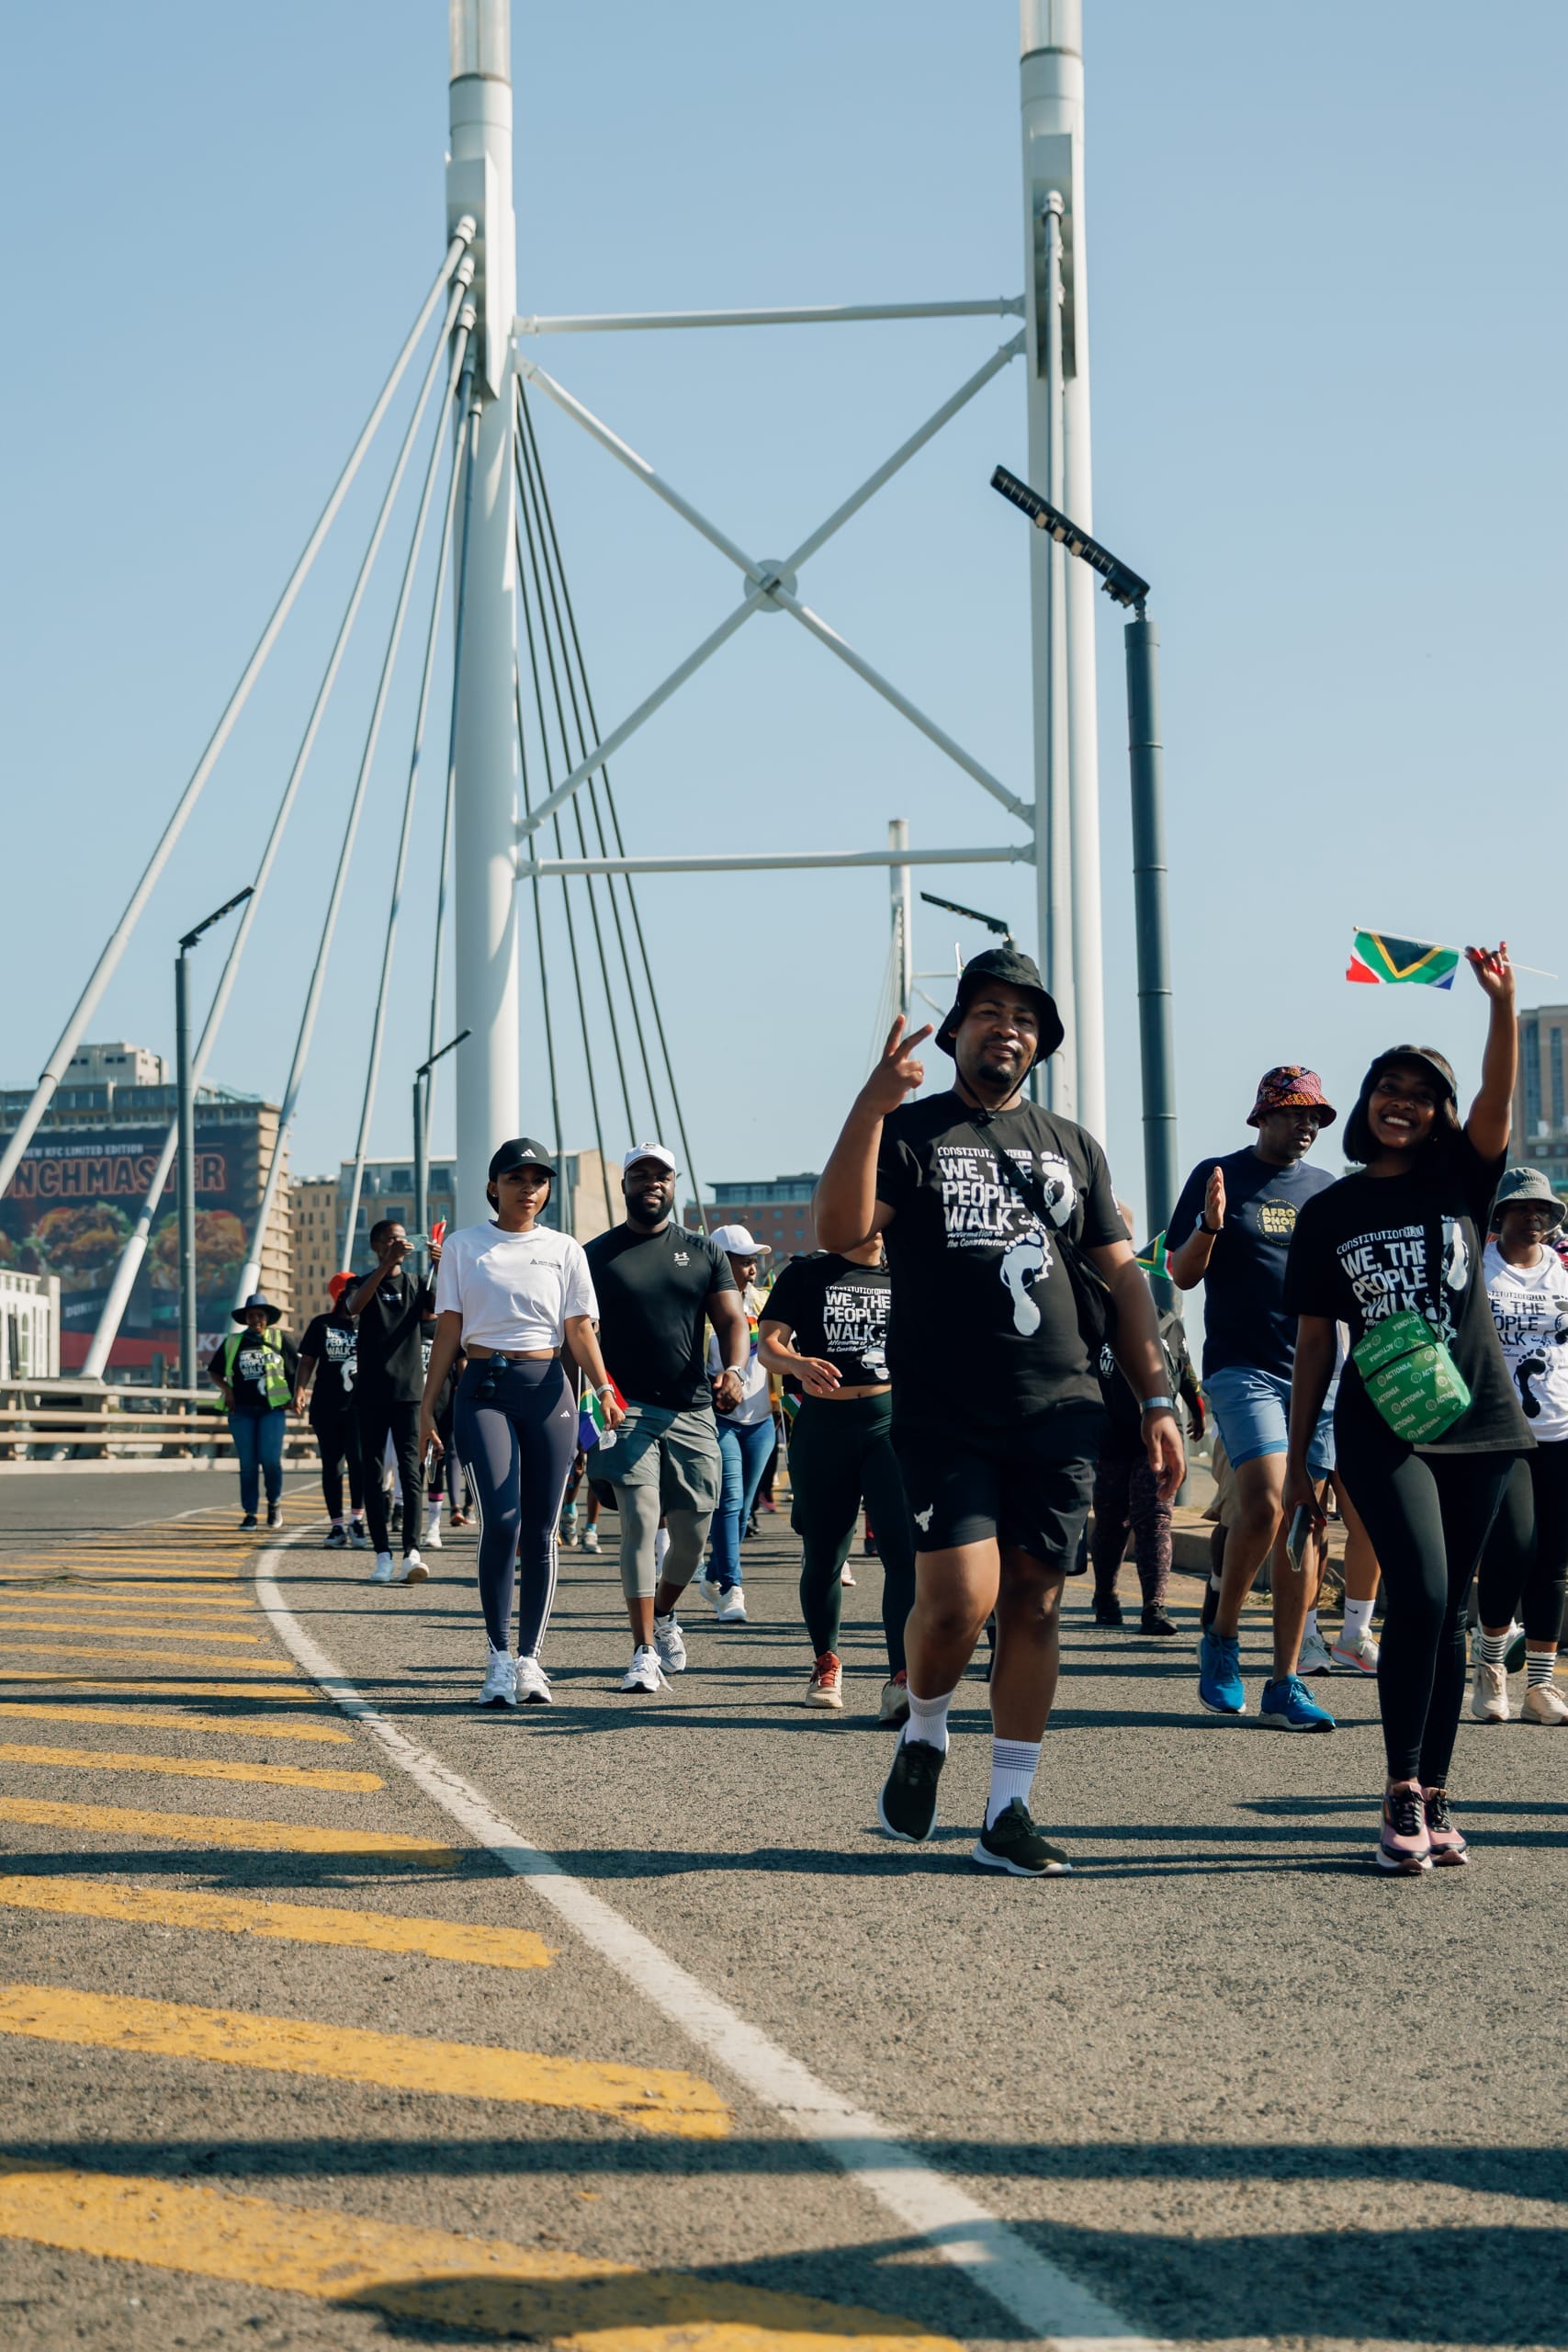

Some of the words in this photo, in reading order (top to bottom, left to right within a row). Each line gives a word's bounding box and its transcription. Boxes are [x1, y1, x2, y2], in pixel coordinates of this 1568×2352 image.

[65, 1145, 103, 1157] LIMITED
[104, 1143, 144, 1156] EDITION
[939, 1158, 985, 1183] WE,
[942, 1181, 1026, 1208] PEOPLE
[942, 1206, 1014, 1232] WALK
[1262, 1207, 1296, 1217] AFRO
[1264, 1224, 1288, 1233] BIA
[960, 1238, 1008, 1247] Constitution
[1341, 1245, 1382, 1279] WE,
[1384, 1239, 1427, 1267] THE
[1352, 1266, 1428, 1306] PEOPLE
[825, 1290, 856, 1309] WE,
[860, 1295, 891, 1309] THE
[1360, 1291, 1421, 1318] WALK
[1488, 1298, 1505, 1315] E,
[1510, 1300, 1547, 1316] THE
[823, 1306, 886, 1325] PEOPLE
[1494, 1315, 1539, 1331] OPLE
[823, 1323, 875, 1341] WALK
[326, 1338, 357, 1347] PEOPLE
[326, 1347, 351, 1355] WALK
